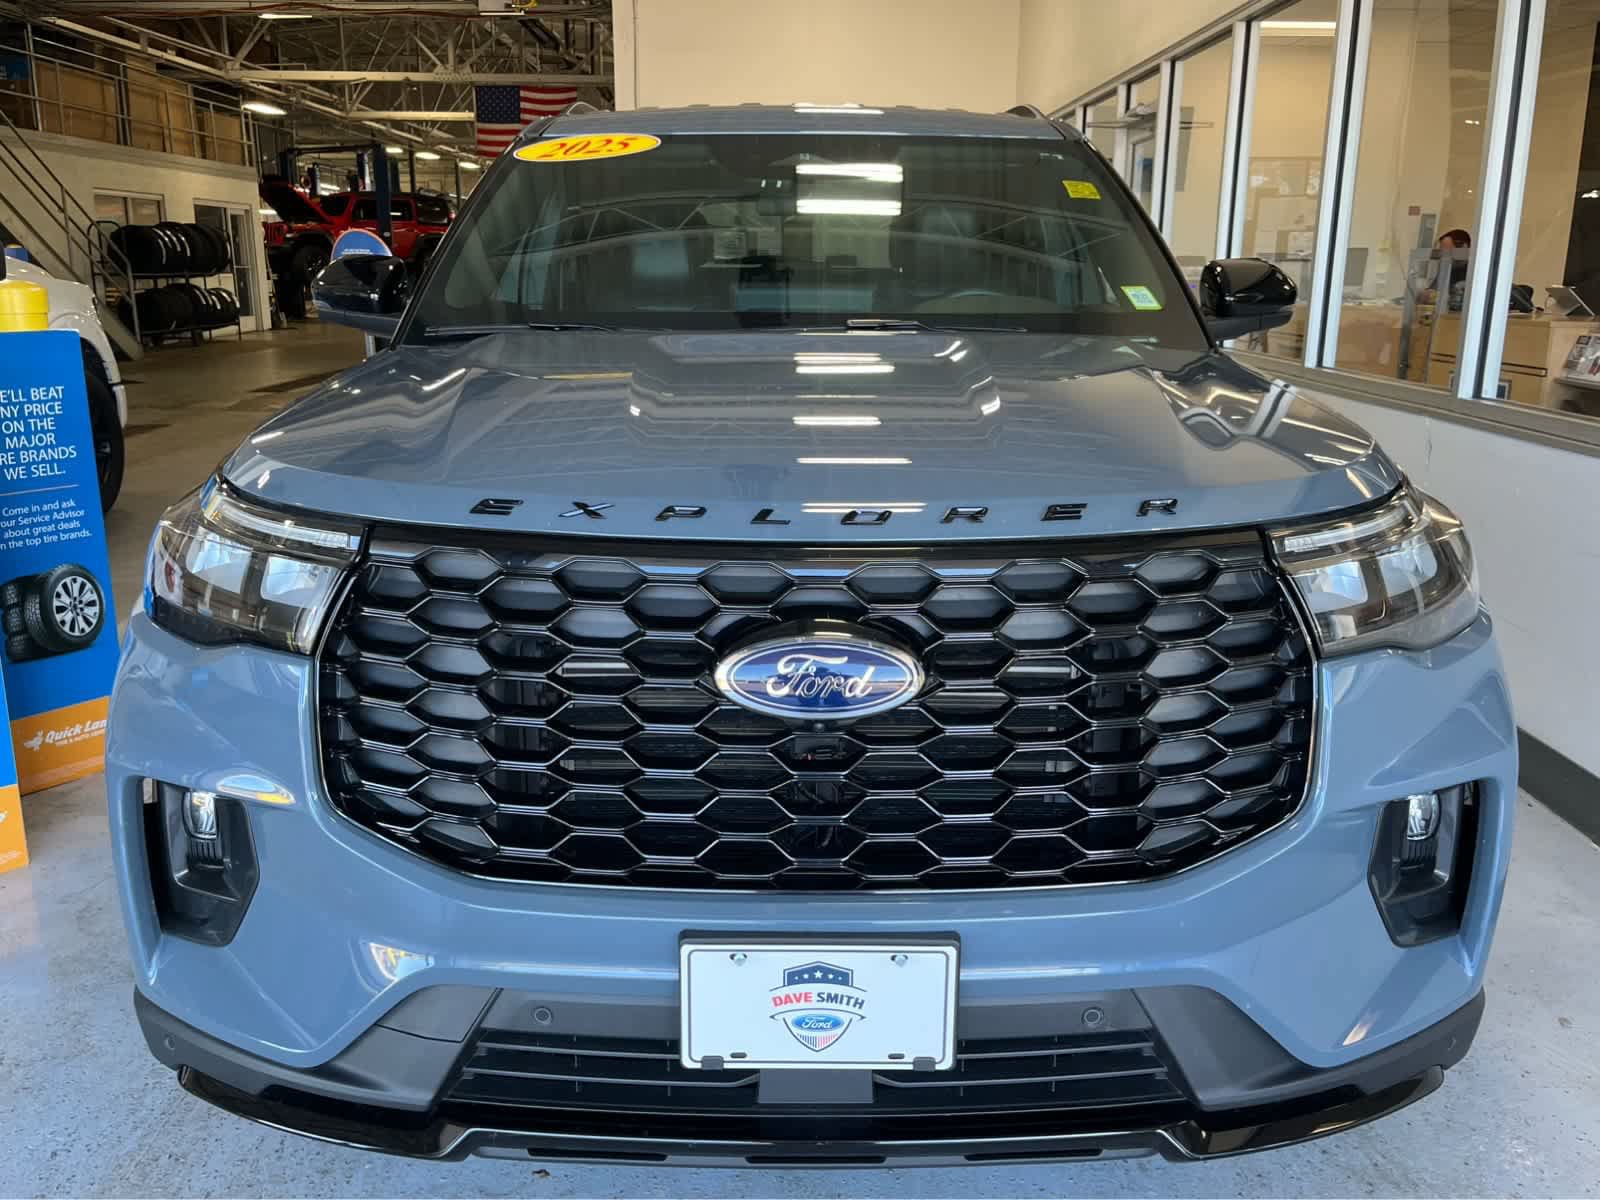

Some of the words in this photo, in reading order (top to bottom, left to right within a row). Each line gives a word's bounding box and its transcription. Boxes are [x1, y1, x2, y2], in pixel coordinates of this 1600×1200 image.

[536, 136, 640, 159] 2025
[0, 388, 27, 404] E'LL
[30, 385, 65, 401] BEAT
[0, 404, 20, 419] NY
[24, 401, 64, 417] PRICE
[1, 420, 25, 434] ON
[27, 417, 57, 432] THE
[5, 432, 56, 449] MAJOR
[0, 452, 17, 466] RE
[20, 445, 77, 463] BRANDS
[4, 465, 28, 480] WE
[31, 462, 66, 478] SELL.
[2, 506, 30, 517] Come
[31, 503, 40, 513] in
[42, 500, 60, 510] and
[61, 498, 76, 509] ask
[469, 497, 1179, 526] EXPLORER
[0, 518, 17, 528] our
[18, 512, 50, 526] Service
[52, 509, 85, 520] Advisor
[4, 527, 31, 539] about
[32, 522, 56, 537] great
[57, 519, 80, 531] deals
[9, 538, 24, 550] the
[25, 536, 42, 547] top
[43, 534, 59, 544] tire
[60, 527, 93, 542] brands.
[765, 653, 877, 698] Ford
[44, 724, 82, 744] Quick
[84, 719, 107, 733] Lan
[772, 991, 813, 1008] DAVE
[816, 991, 866, 1010] SMITH
[801, 1015, 833, 1029] Ford
